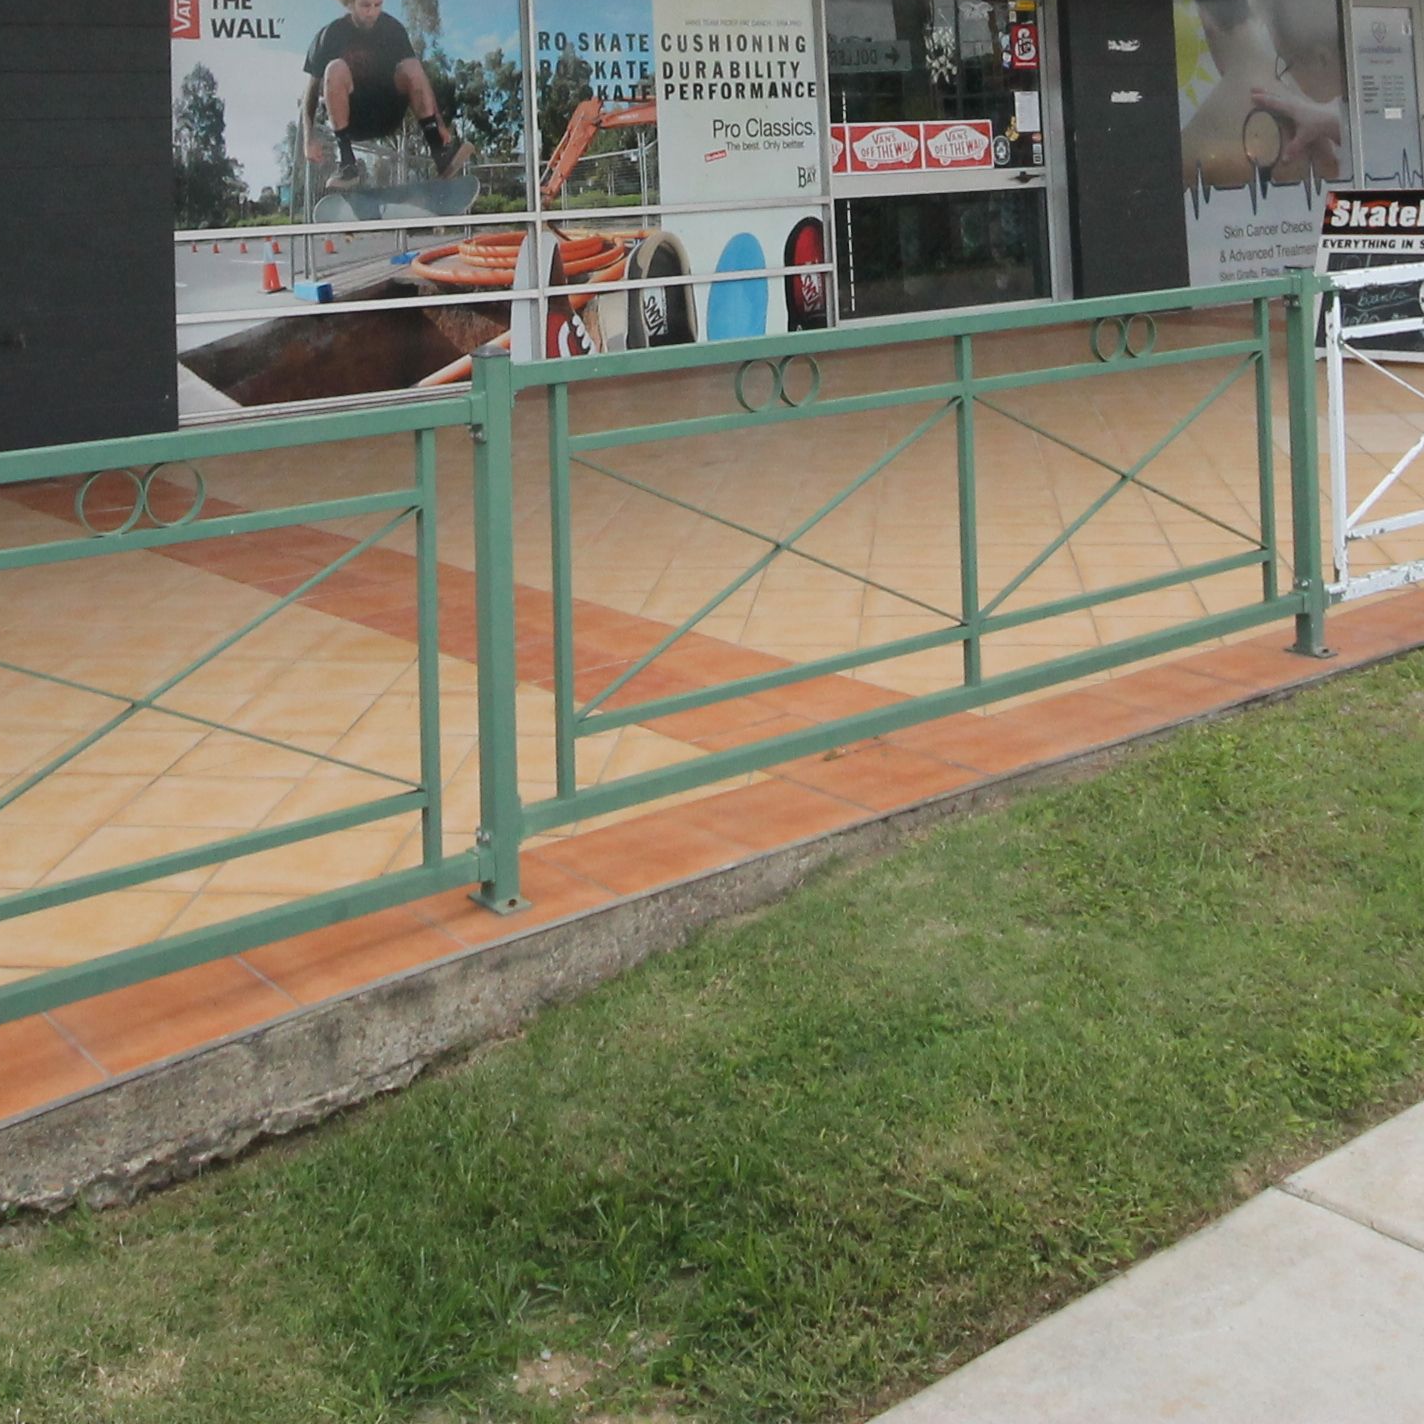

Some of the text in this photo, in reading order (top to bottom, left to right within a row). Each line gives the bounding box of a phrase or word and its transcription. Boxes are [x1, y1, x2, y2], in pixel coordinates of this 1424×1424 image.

[578, 32, 650, 53] SKATE
[660, 33, 807, 54] CUSHIONING
[662, 60, 801, 81] DURABILITY
[664, 81, 817, 102] PERFORMANCE
[713, 117, 817, 139] Pro Classics.
[944, 129, 968, 142] VANS
[871, 131, 897, 145] VANS
[726, 141, 740, 151] The
[860, 147, 876, 159] OFF
[877, 145, 894, 159] THE
[934, 144, 950, 156] OFF
[950, 143, 967, 157] THE
[1224, 220, 1313, 239] Skin Cancer Checks
[1322, 238, 1396, 250] EVERYTHING
[1401, 238, 1415, 249] IN
[1229, 245, 1274, 262] Advanced
